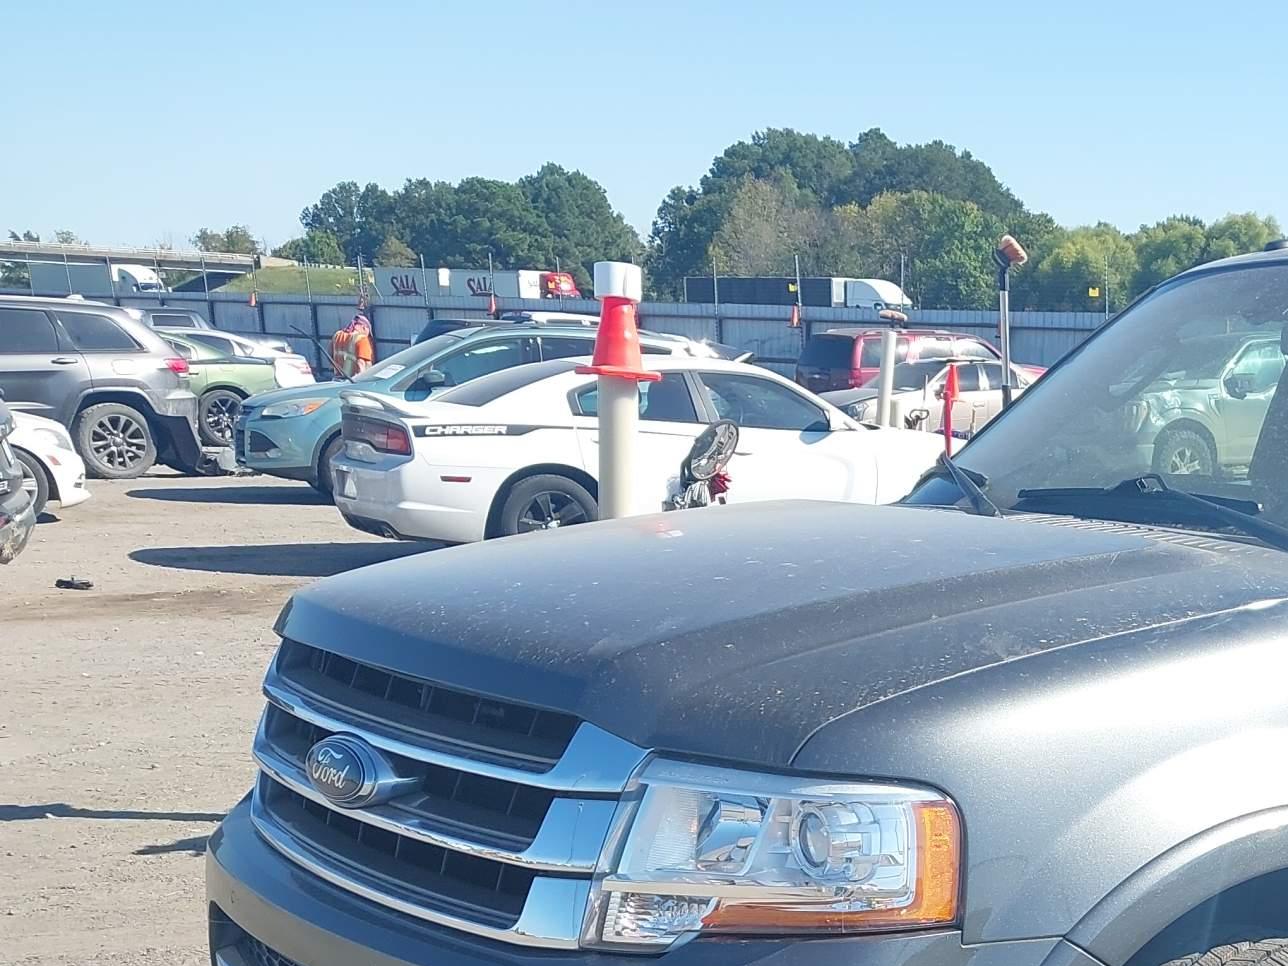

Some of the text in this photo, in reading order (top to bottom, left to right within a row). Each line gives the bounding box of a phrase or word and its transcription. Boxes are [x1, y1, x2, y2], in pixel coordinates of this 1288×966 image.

[390, 275, 420, 295] SAIA
[425, 425, 507, 435] CHARGER
[312, 747, 350, 789] Ford
